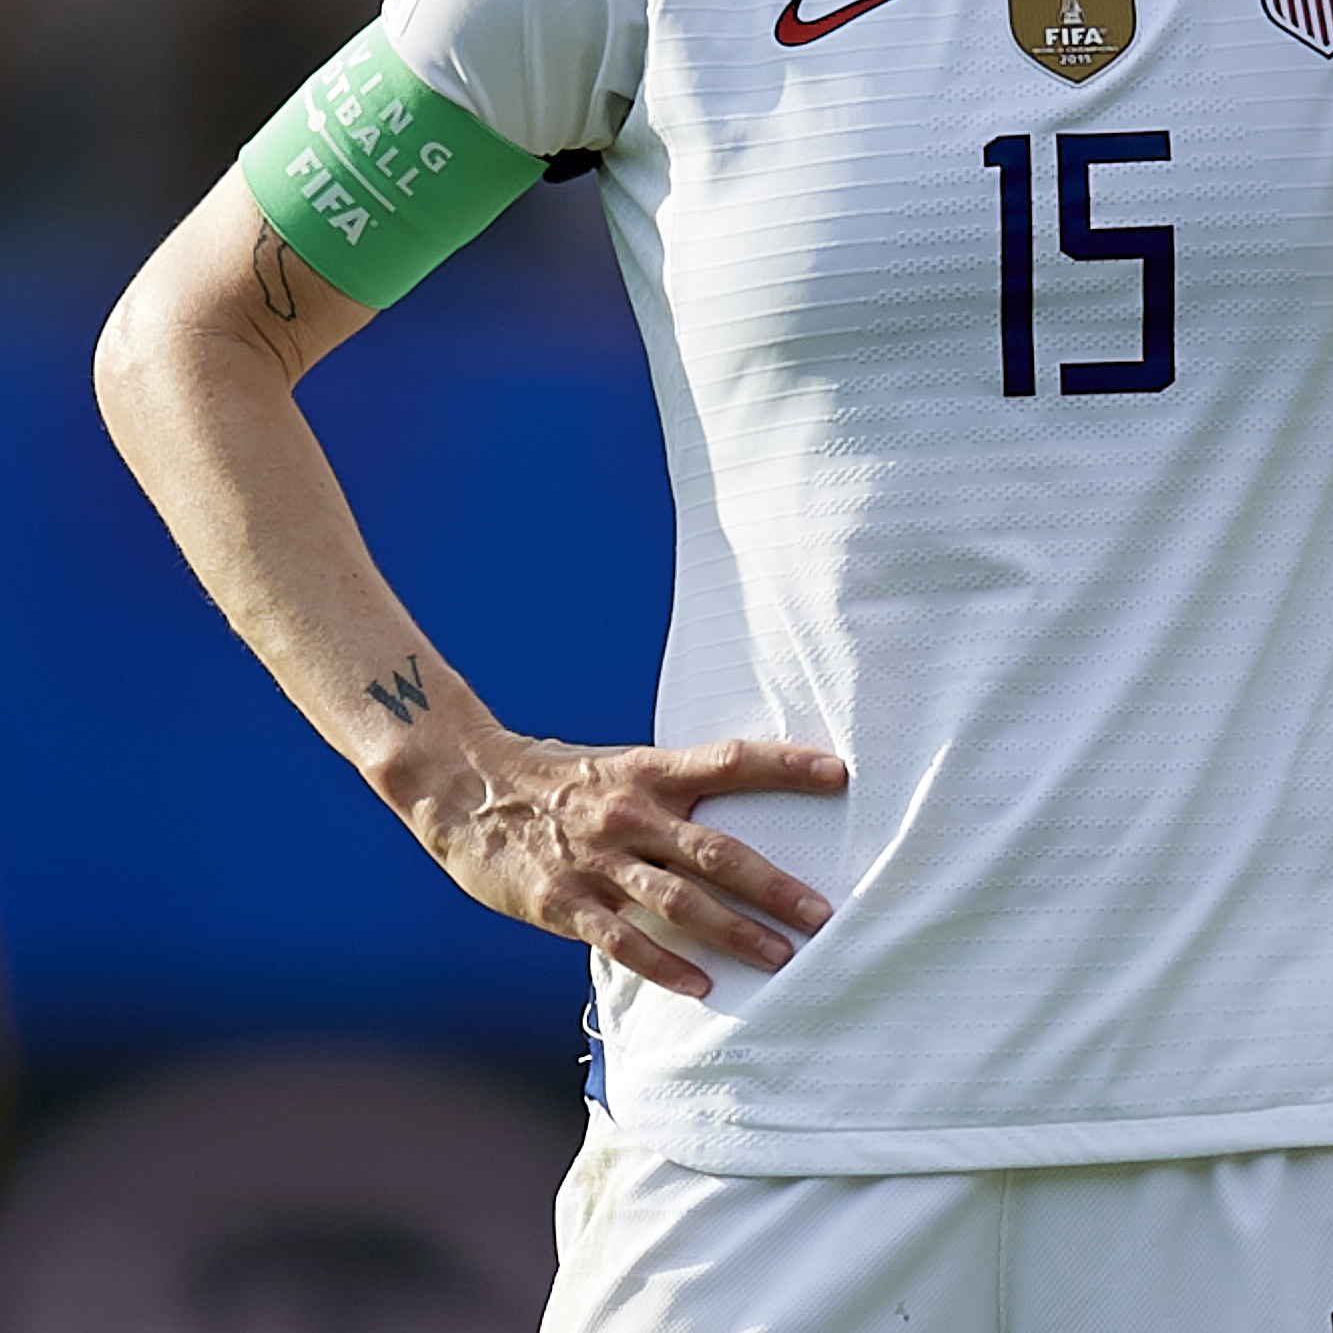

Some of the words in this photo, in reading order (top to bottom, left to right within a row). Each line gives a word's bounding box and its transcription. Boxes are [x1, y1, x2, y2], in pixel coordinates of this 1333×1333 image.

[1045, 27, 1104, 46] FIFA
[284, 146, 372, 246] FIFA
[984, 130, 1175, 396] 15
[364, 654, 430, 724] W
